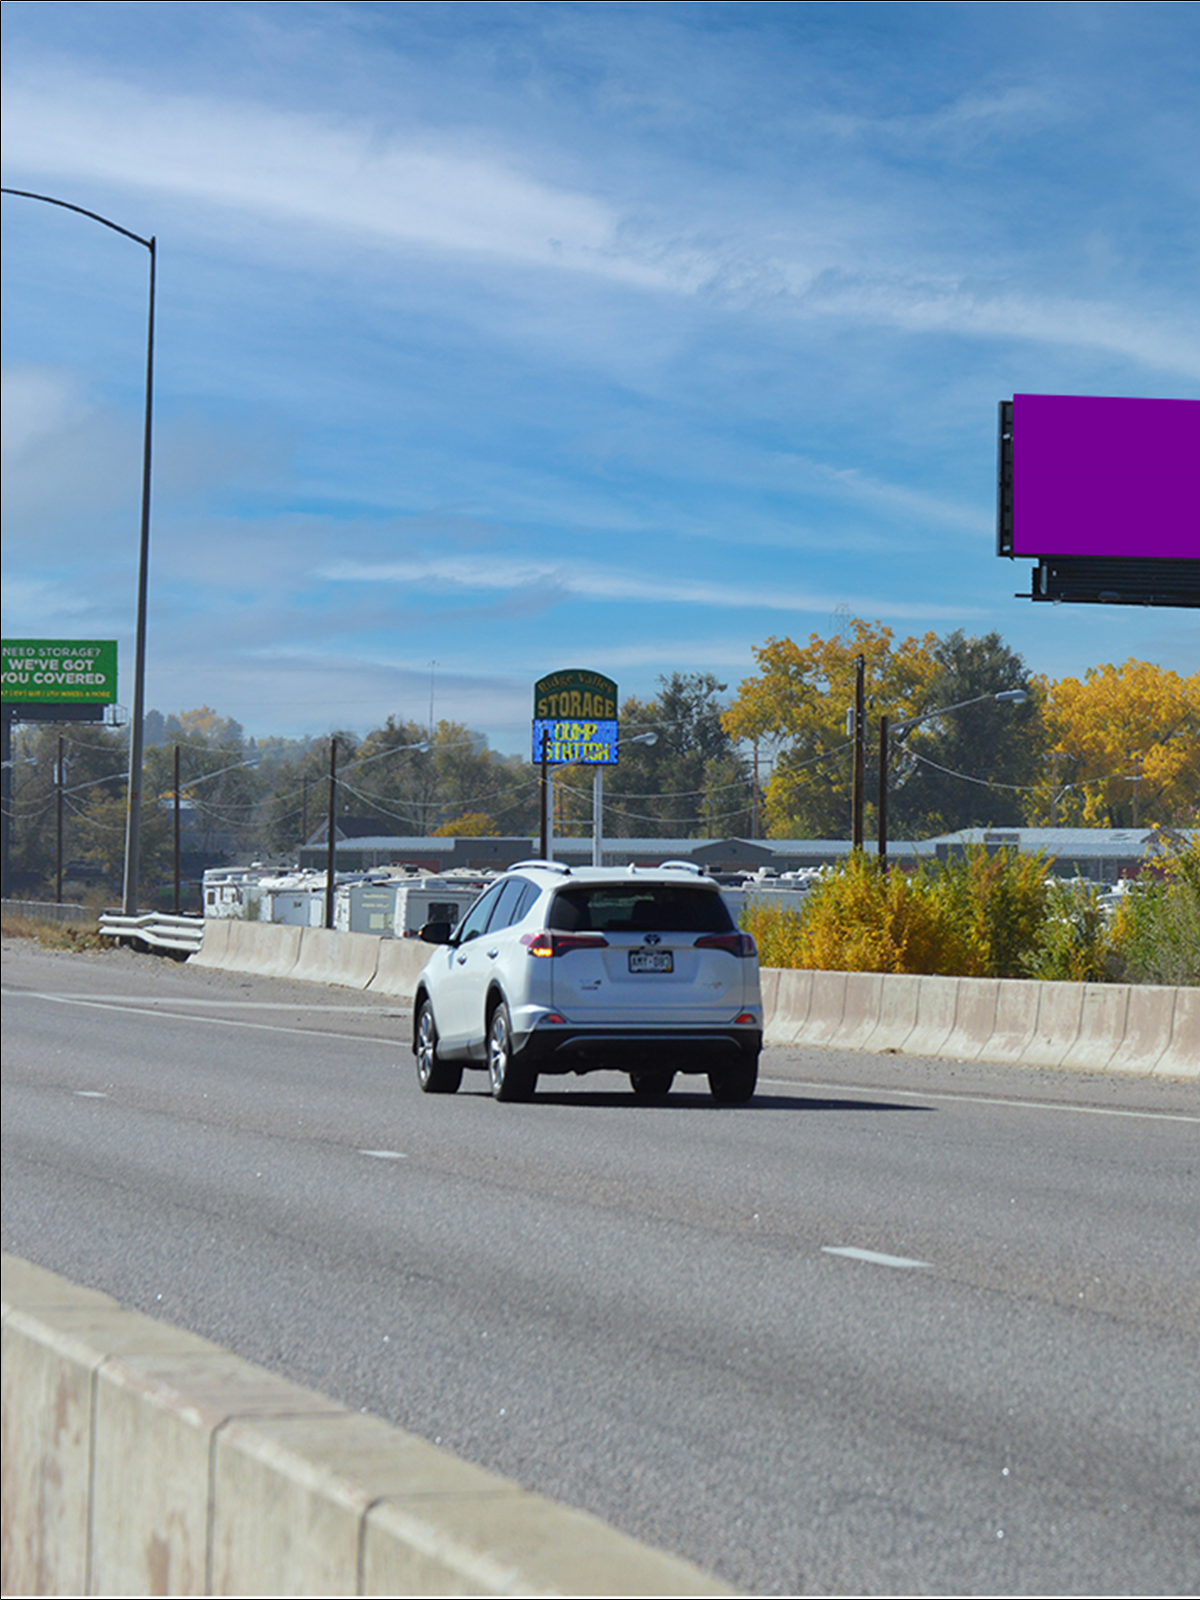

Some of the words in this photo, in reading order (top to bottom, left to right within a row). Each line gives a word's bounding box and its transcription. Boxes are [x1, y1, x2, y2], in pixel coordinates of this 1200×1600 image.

[2, 647, 36, 657] NEED
[38, 647, 101, 658] STORAGE?
[8, 659, 60, 671] WE'VE
[62, 660, 94, 671] GOT
[1, 672, 29, 684] YOU
[33, 672, 106, 684] COVERED
[537, 690, 615, 718] STORAGE
[554, 723, 597, 741] DUMP
[545, 741, 610, 760] STATION
